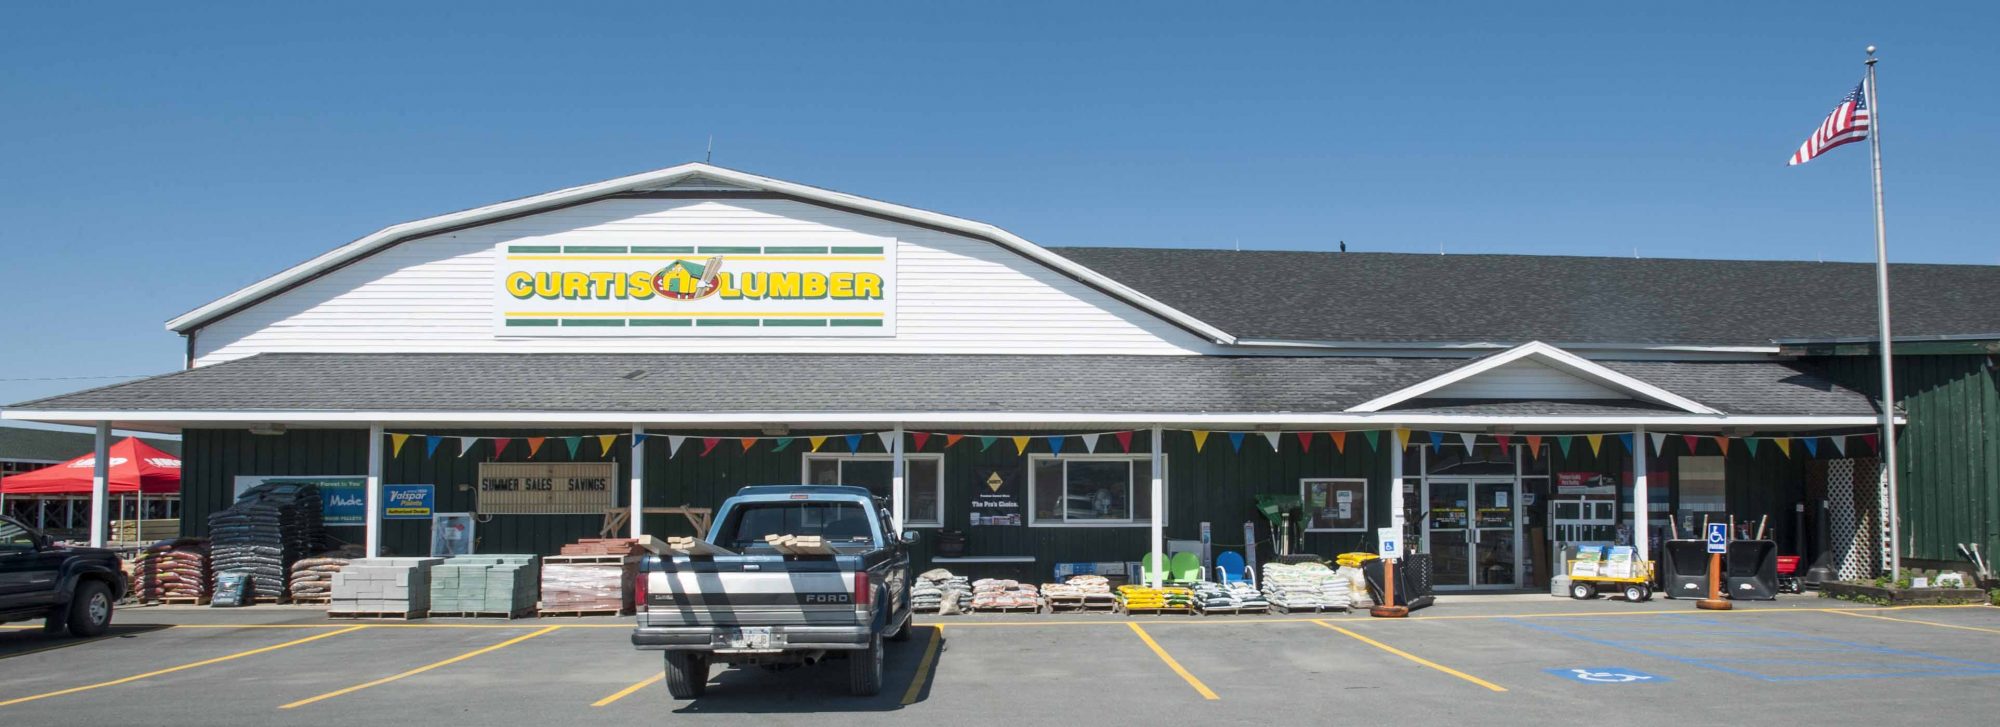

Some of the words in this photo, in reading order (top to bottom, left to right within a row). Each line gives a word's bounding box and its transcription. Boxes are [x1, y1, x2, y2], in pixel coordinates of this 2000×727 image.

[505, 271, 654, 300] CURTIS
[719, 271, 885, 300] LUMBER
[482, 478, 519, 491] SUMMER
[525, 478, 552, 491] SALES
[568, 478, 605, 491] SAVINGS
[329, 494, 364, 507] Made
[390, 490, 427, 502] Valspar
[805, 594, 849, 602] FORD
